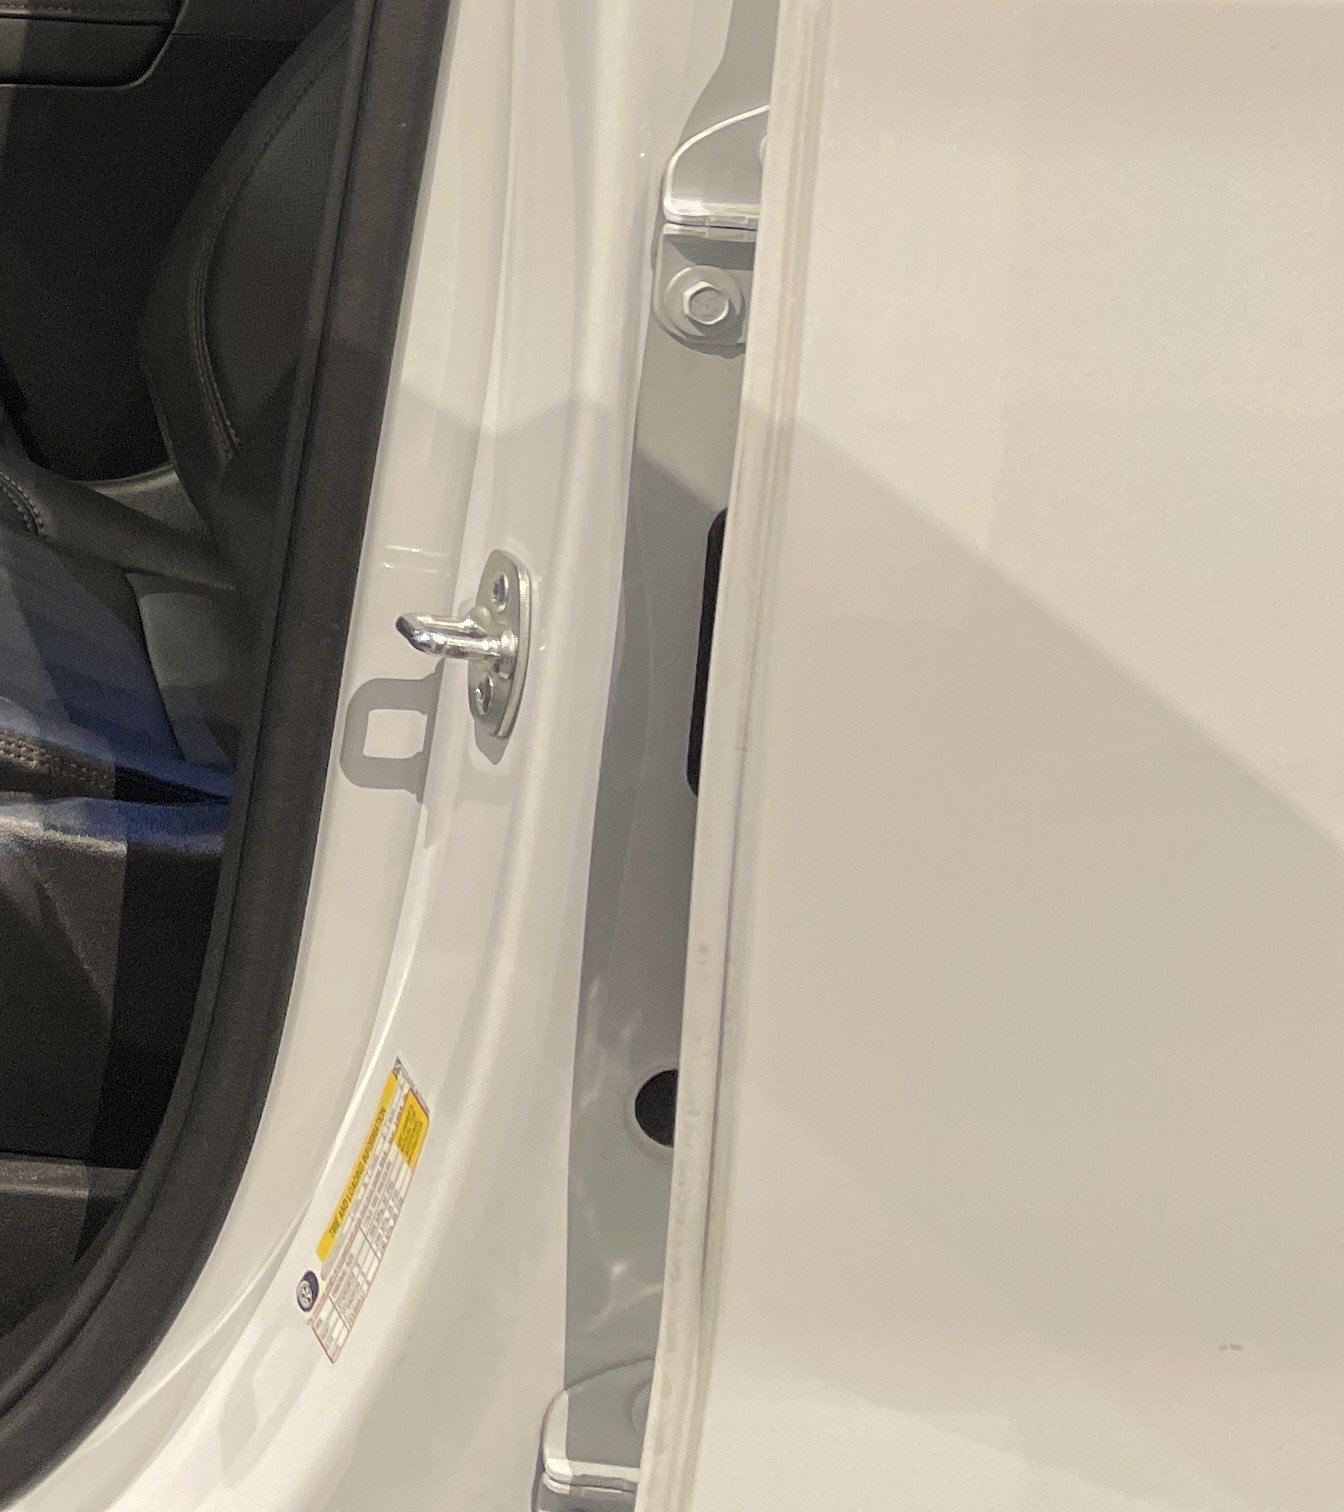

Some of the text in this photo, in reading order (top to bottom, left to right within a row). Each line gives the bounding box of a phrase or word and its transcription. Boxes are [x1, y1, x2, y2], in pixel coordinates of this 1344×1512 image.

[329, 1108, 386, 1238] TIRE AND LOADING INFORMATION
